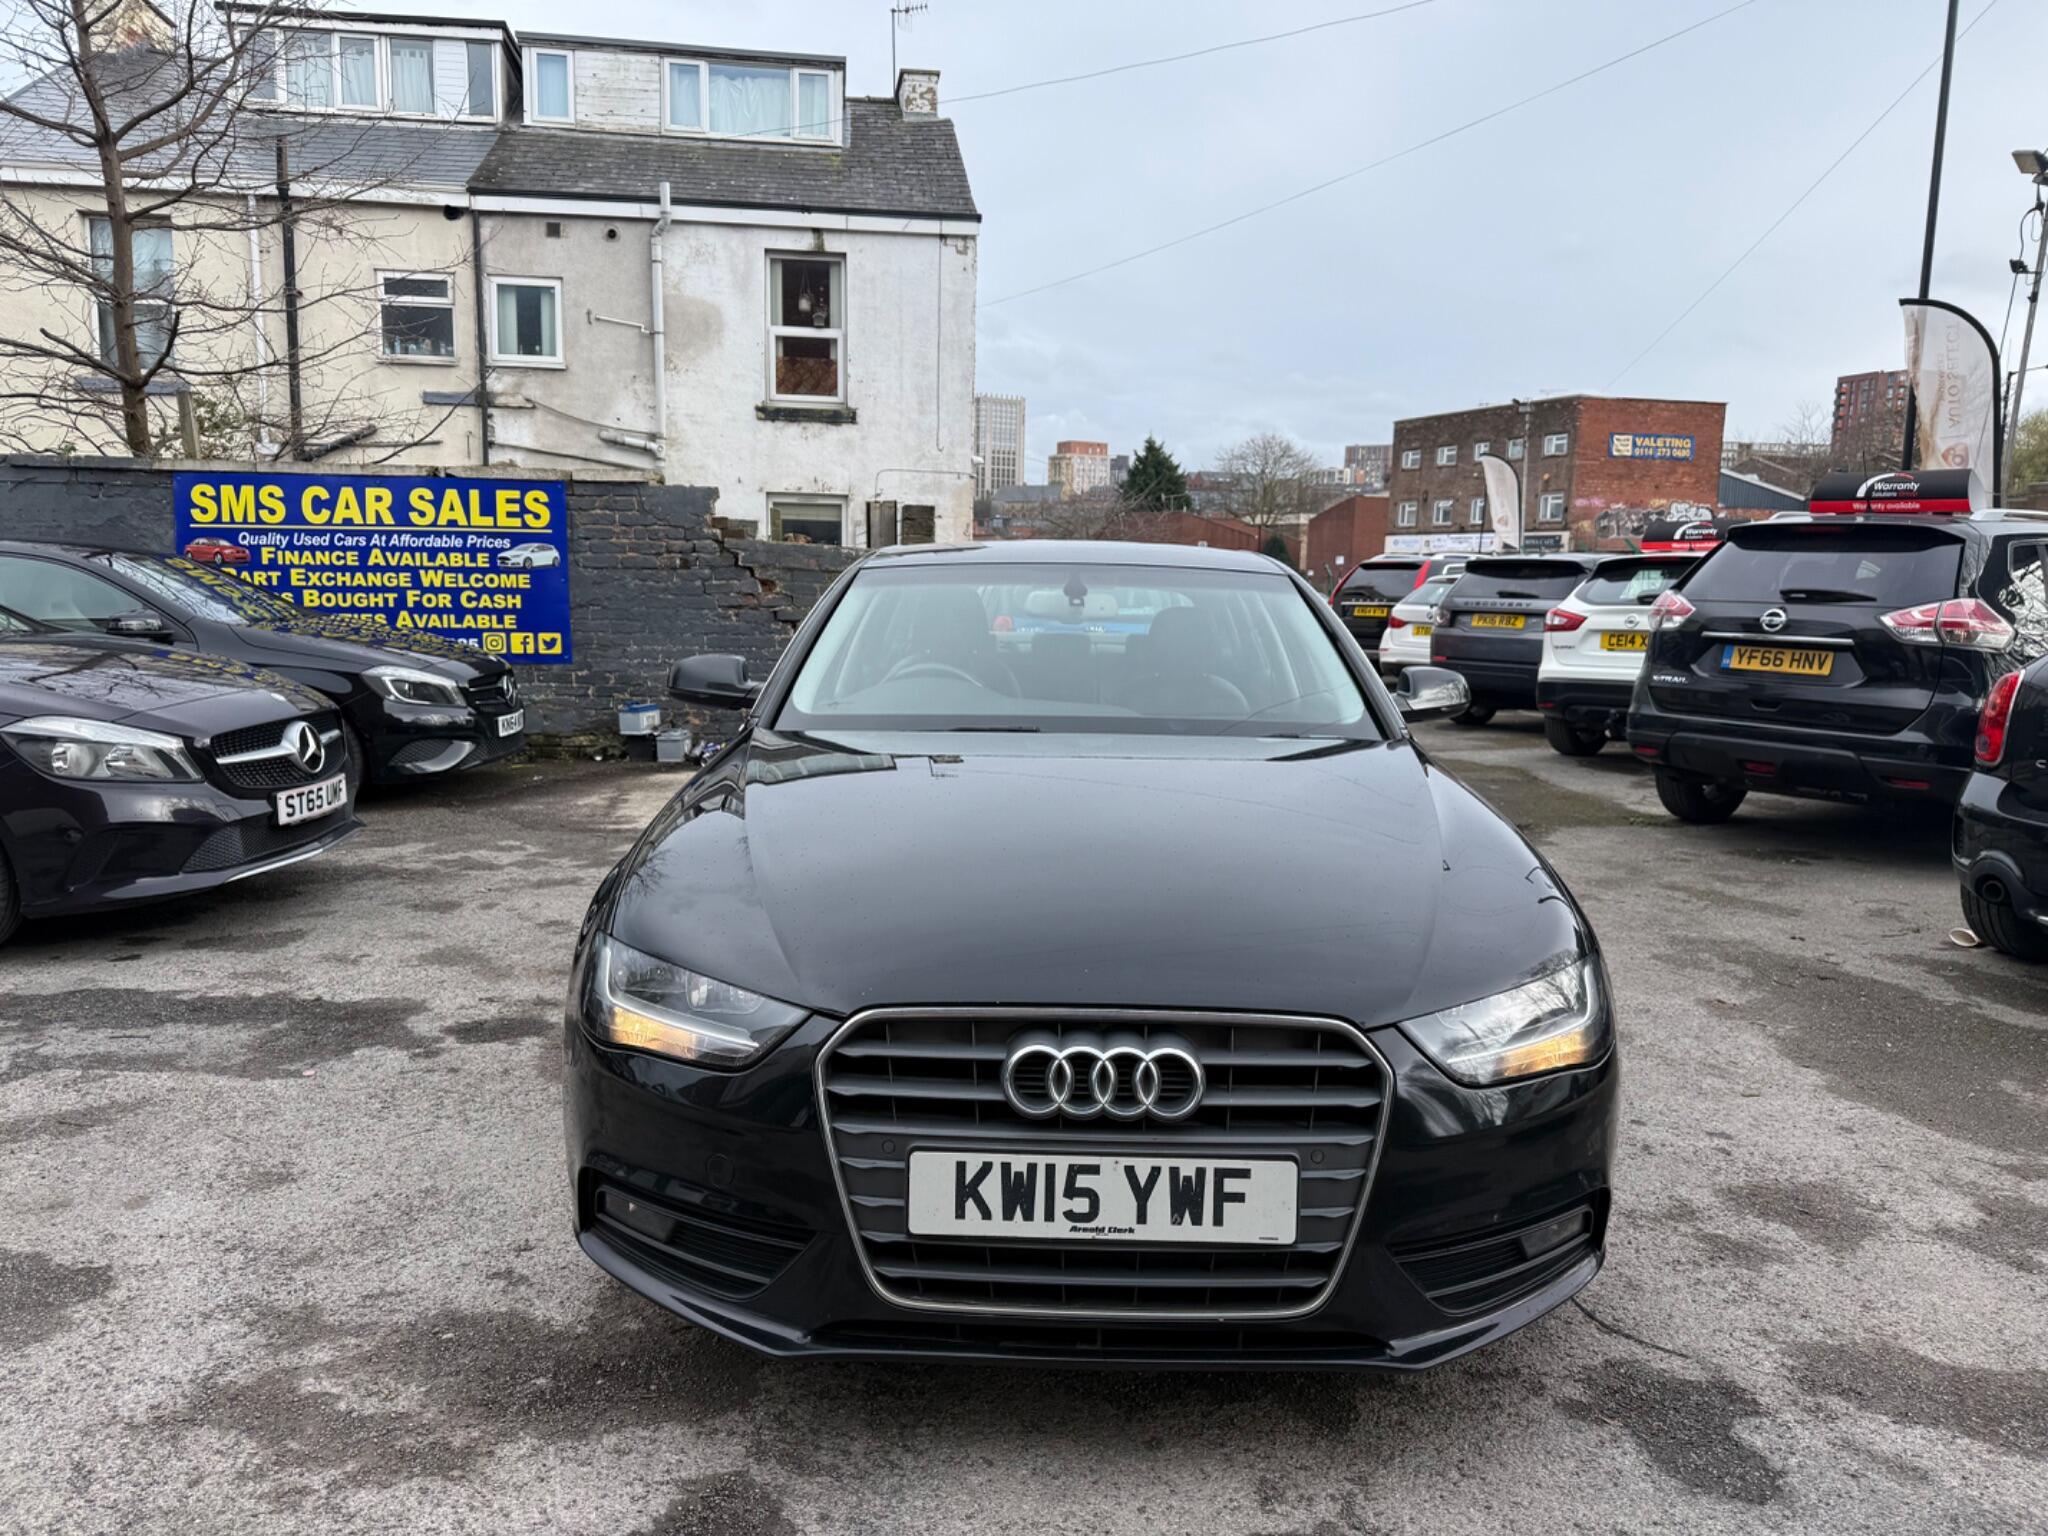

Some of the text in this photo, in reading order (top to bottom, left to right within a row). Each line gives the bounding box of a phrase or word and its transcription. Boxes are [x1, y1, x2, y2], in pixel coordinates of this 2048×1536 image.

[1635, 437, 1692, 448] VALETING
[1873, 481, 1920, 492] Warranty
[190, 484, 551, 528] SMS CAR SALES
[238, 532, 511, 549] Quality Used Cars At Affordable Prices
[261, 547, 490, 567] FINANCE AVAILABLE
[290, 568, 412, 587] EXCHANGE
[419, 570, 531, 588] WELCOME
[303, 589, 398, 608] BOUGHT
[406, 590, 452, 608] FOR
[460, 590, 522, 609] CASH
[396, 611, 517, 629] AVAILABLE
[1608, 634, 1636, 647] CE14
[1736, 647, 1829, 670] YF66 HNV
[285, 787, 324, 817] ST65
[955, 1160, 1251, 1227] KW15 YWF
[1069, 1225, 1106, 1234] Arnold
